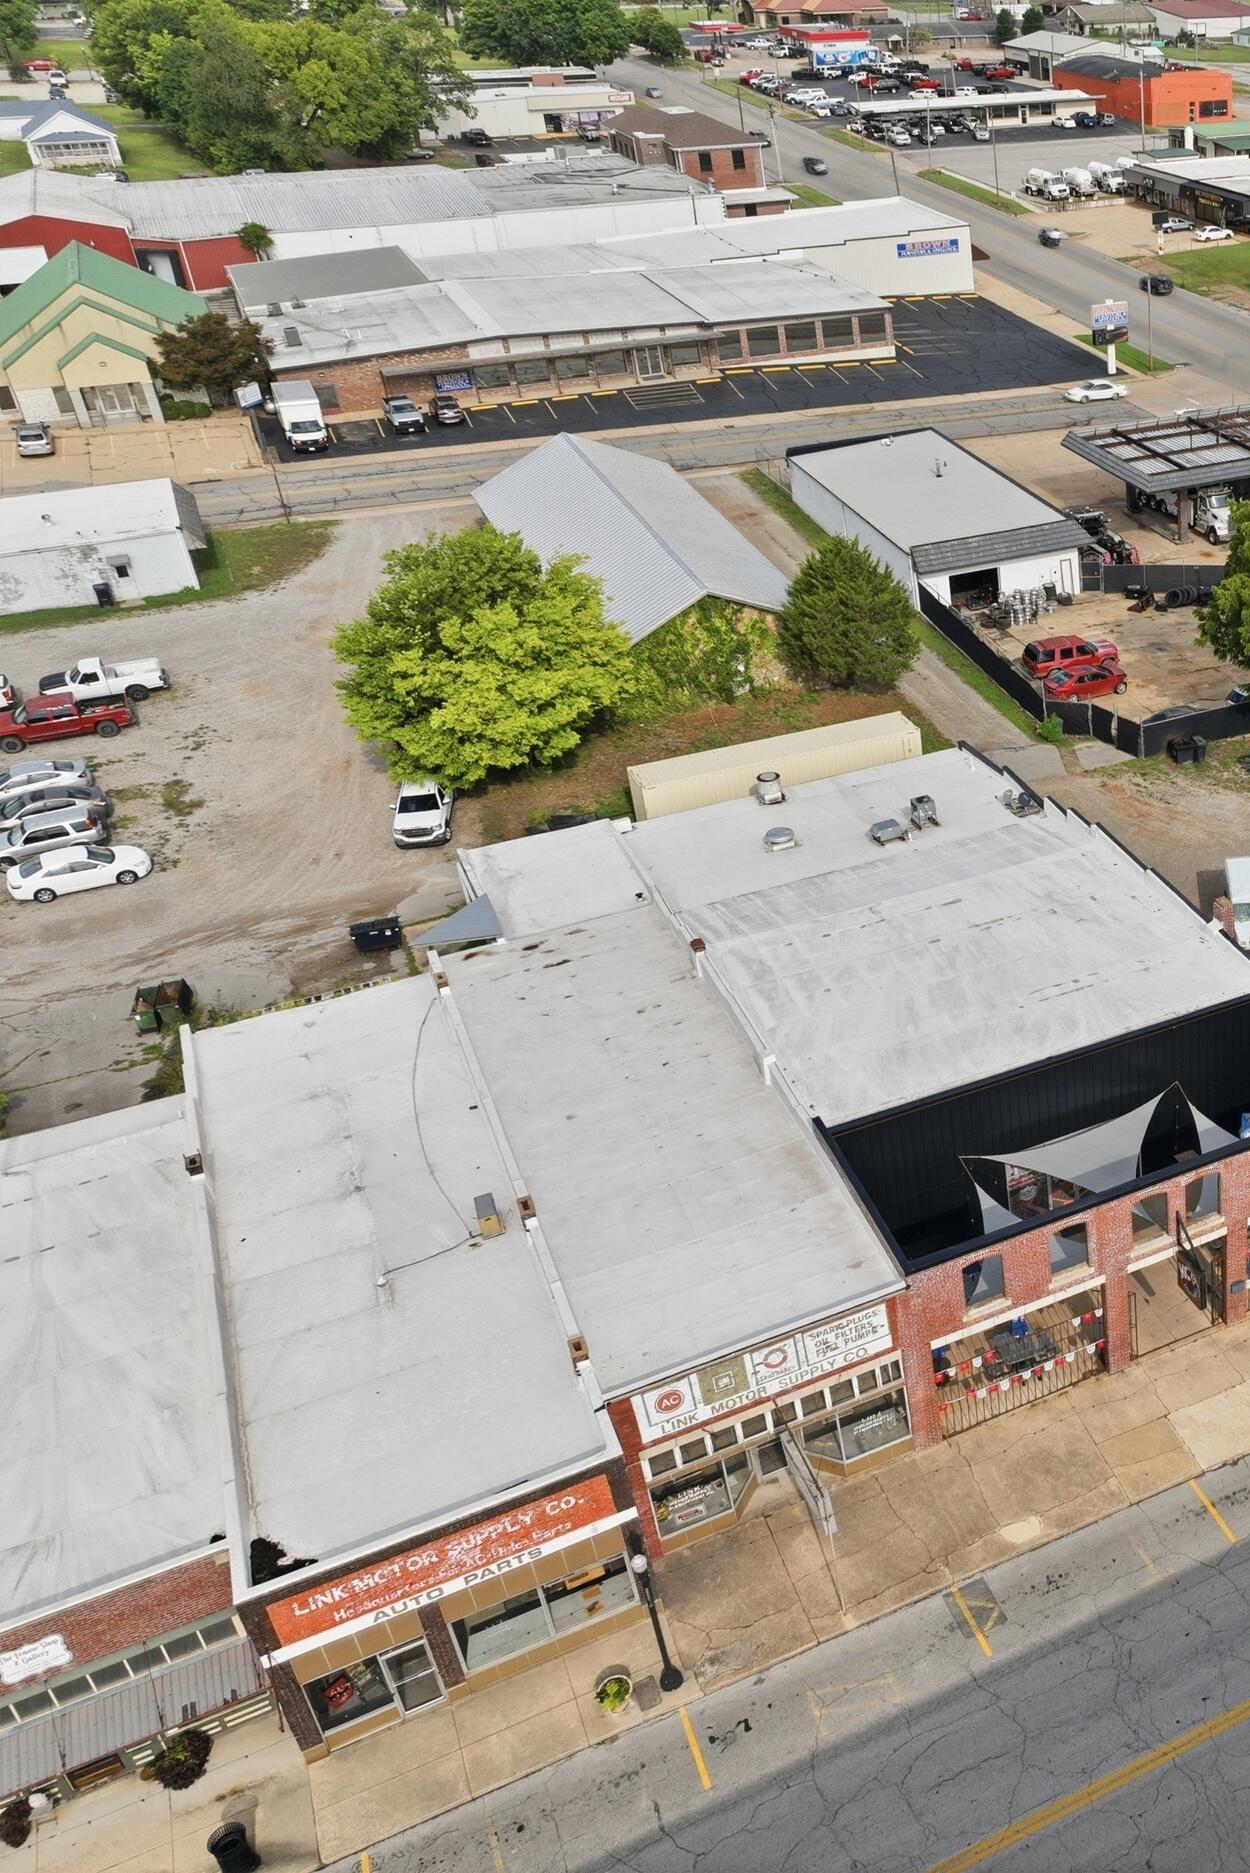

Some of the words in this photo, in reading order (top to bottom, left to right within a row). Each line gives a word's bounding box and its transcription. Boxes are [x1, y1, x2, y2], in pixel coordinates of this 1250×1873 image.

[808, 1322, 844, 1341] SPARK
[844, 1309, 878, 1327] PLUGS
[834, 1320, 873, 1340] FILTERS
[844, 1326, 878, 1346] PUMPS
[660, 1411, 700, 1434] LINK
[710, 1385, 768, 1415] MOTOR
[778, 1358, 836, 1389] SUPPLY
[661, 1395, 680, 1409] AC
[291, 1582, 350, 1617] LINK
[351, 1549, 440, 1593] MOTOR
[447, 1510, 533, 1559] SUPPLY
[545, 1495, 585, 1516] CO.
[372, 1586, 445, 1624] AUTO
[463, 1547, 543, 1586] PARTS
[22, 1650, 49, 1664] Gallery
